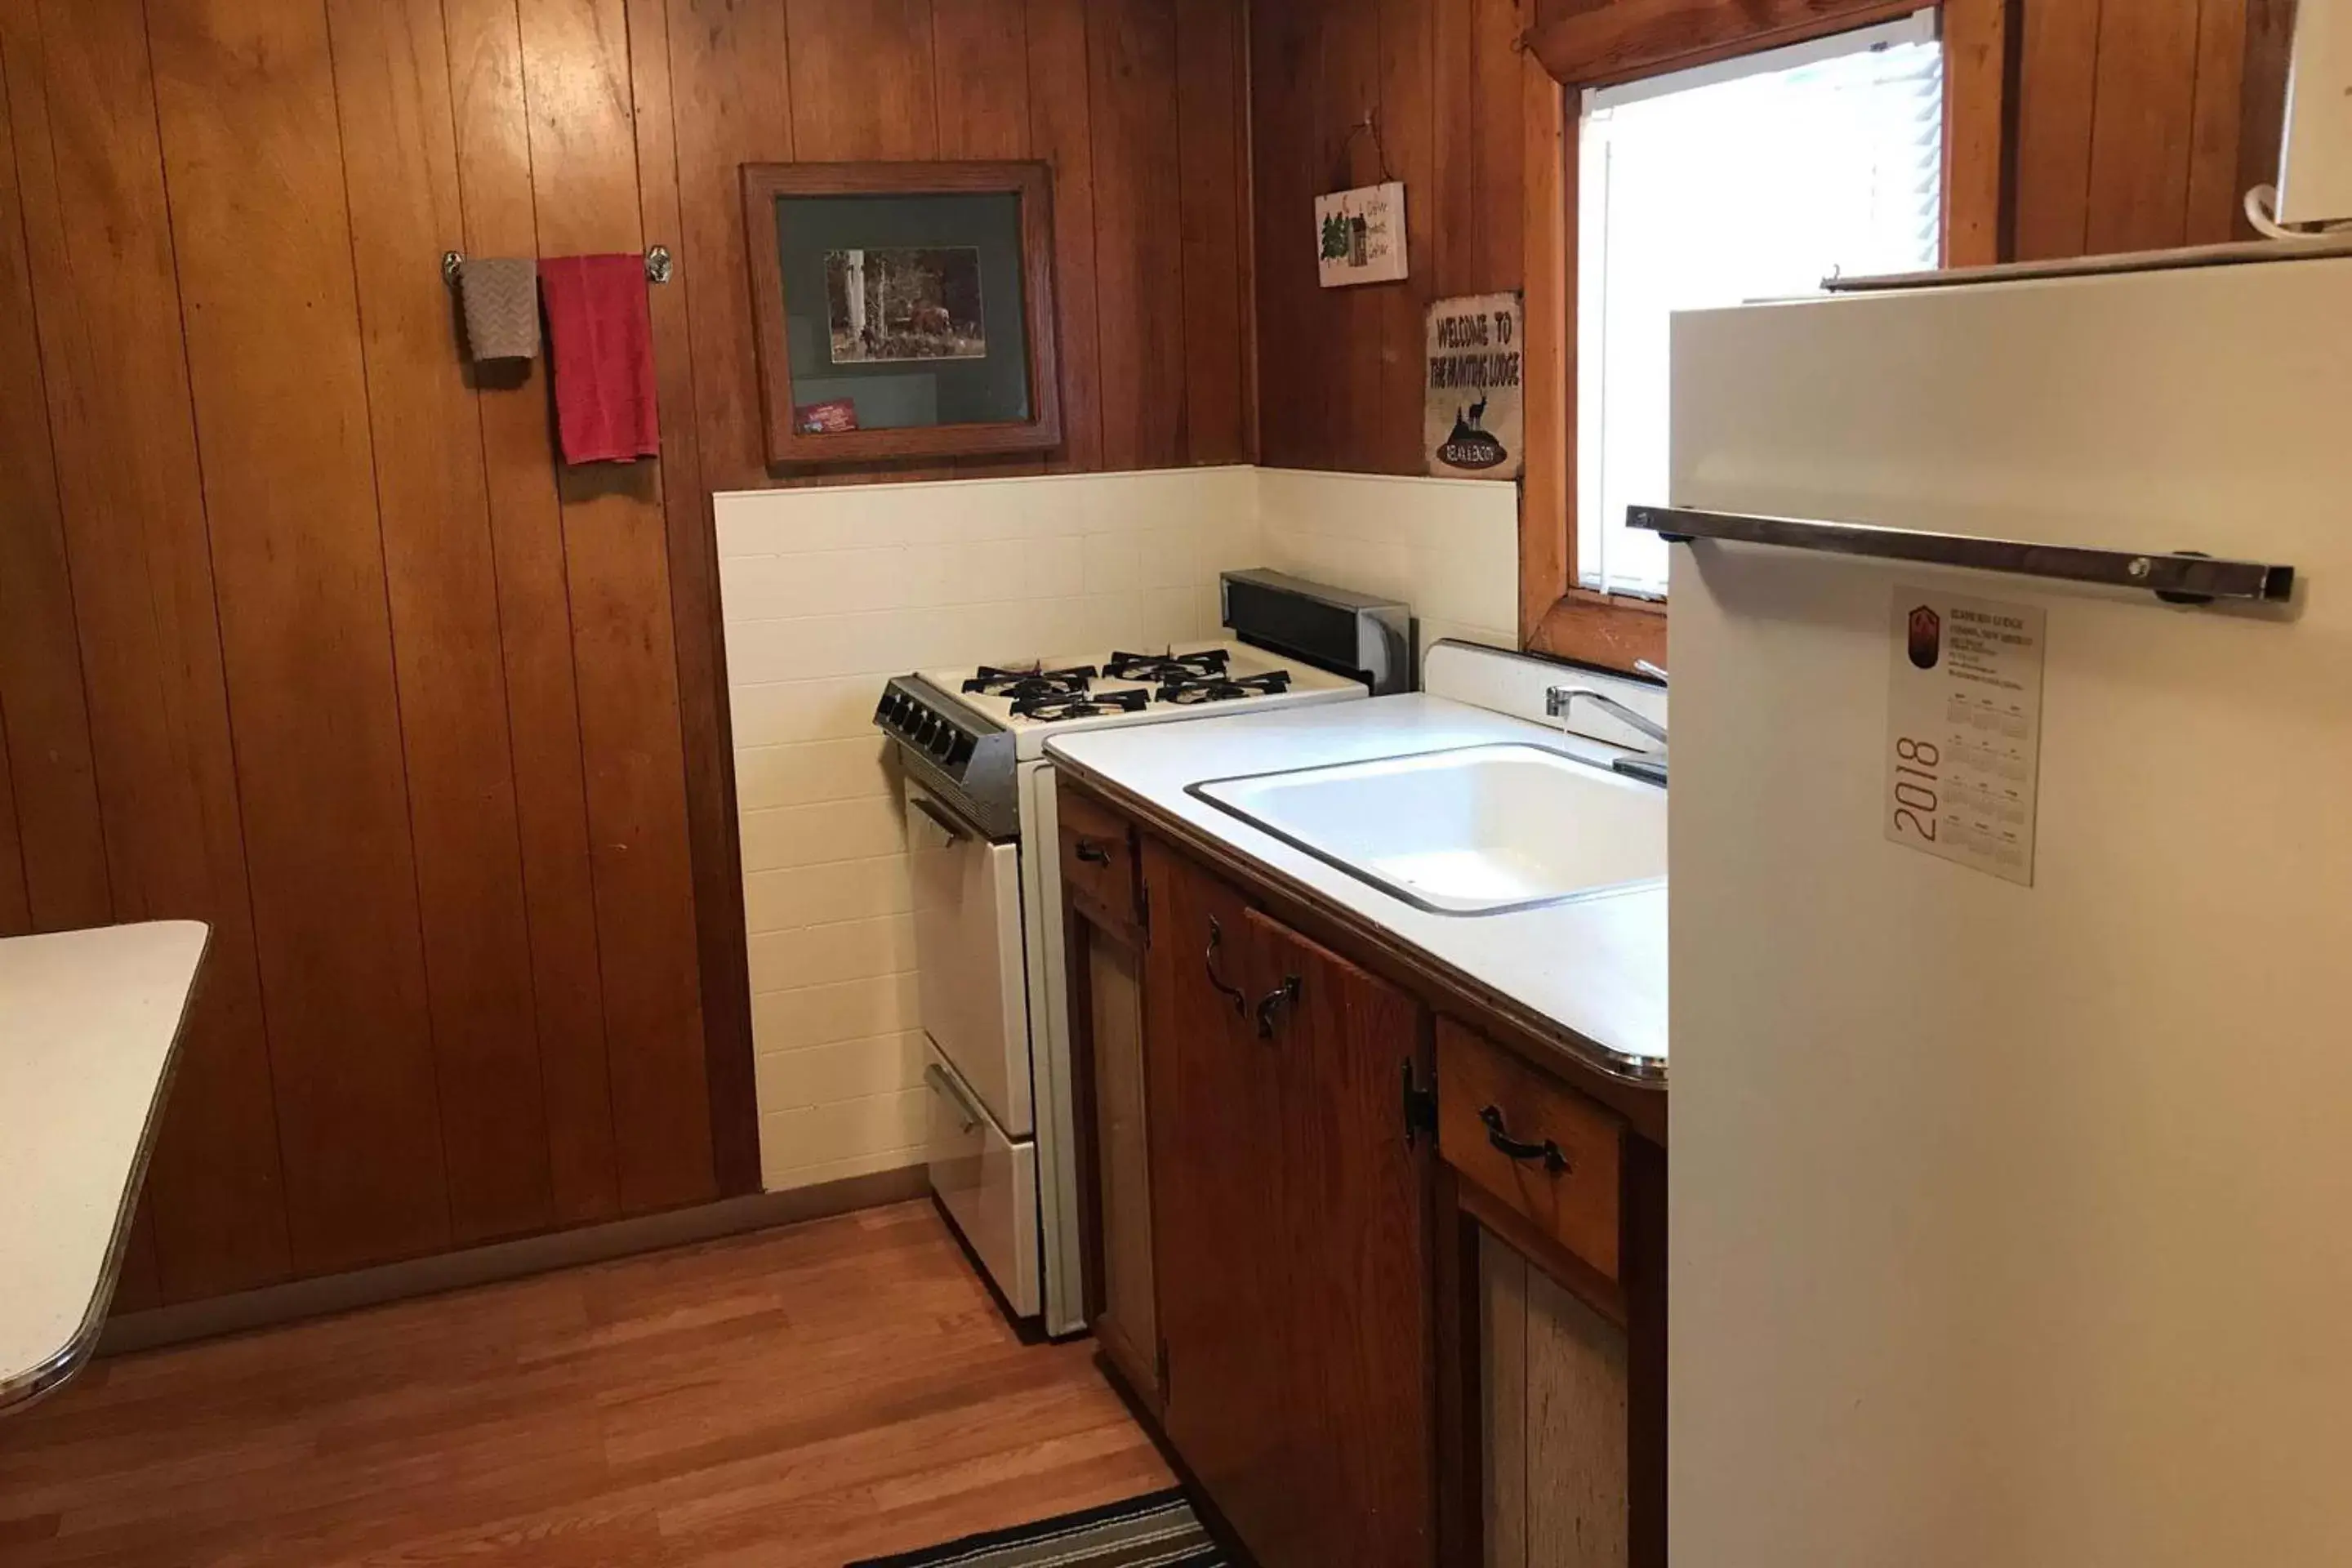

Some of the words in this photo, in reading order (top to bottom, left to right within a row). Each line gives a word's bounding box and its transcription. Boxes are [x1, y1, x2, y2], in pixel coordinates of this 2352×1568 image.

[1436, 314, 1489, 350] WELCOME
[1494, 311, 1512, 345] TO
[1429, 356, 1446, 390] THE
[1447, 353, 1487, 390] HUNTING
[1489, 350, 1520, 388] LODGE
[1894, 737, 1940, 842] 2018
